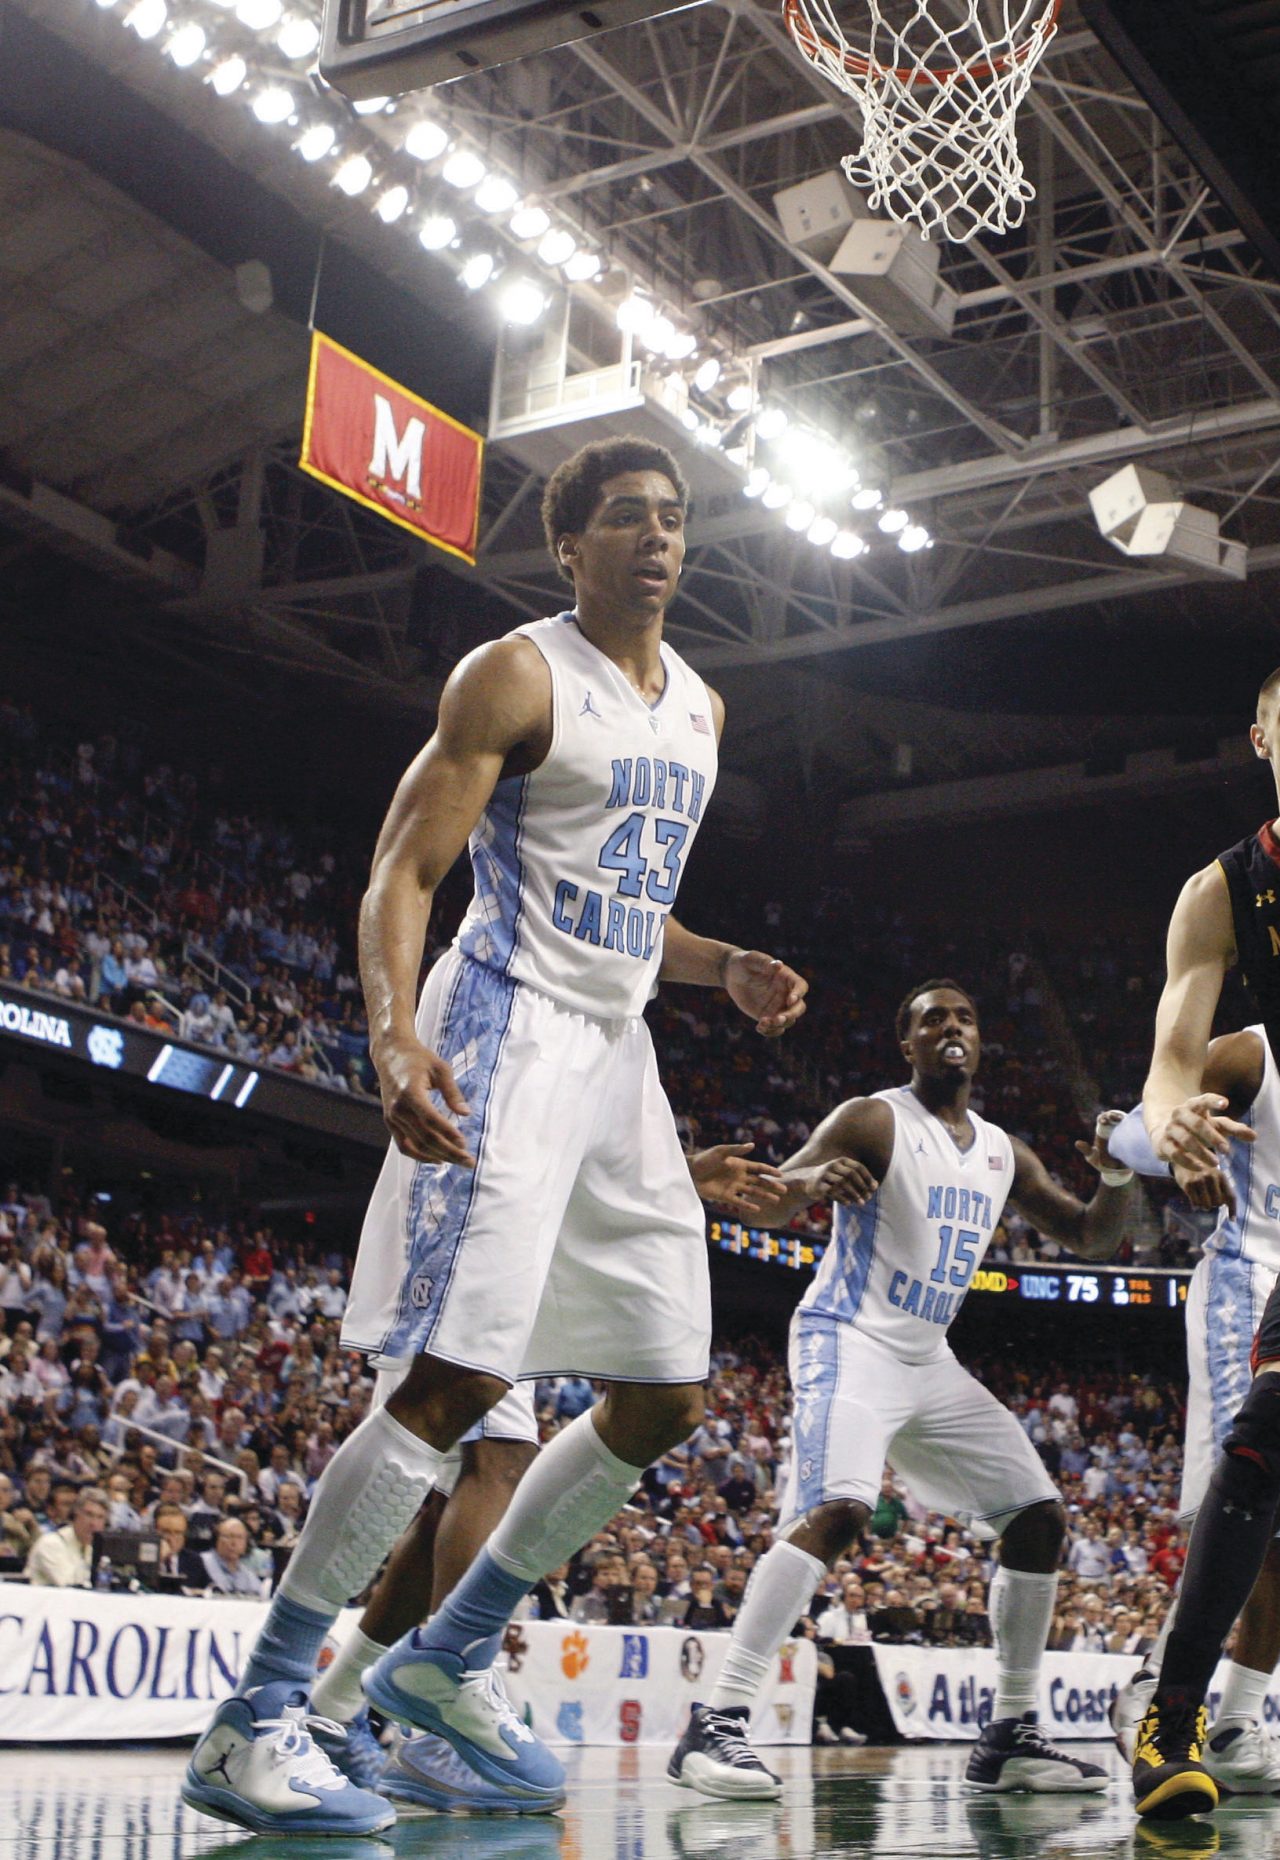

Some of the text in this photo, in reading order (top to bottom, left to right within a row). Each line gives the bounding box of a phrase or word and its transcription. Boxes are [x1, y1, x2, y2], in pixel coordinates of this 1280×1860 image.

[368, 393, 426, 500] M
[605, 756, 705, 823] NORTH
[598, 812, 689, 904] 43
[0, 1000, 72, 1048] OLINA
[927, 1186, 992, 1230] NORTH
[930, 1225, 979, 1288] 15
[1020, 1274, 1060, 1299] UNC
[1066, 1275, 1099, 1302] 75
[1115, 1277, 1125, 1291] 3
[928, 1673, 997, 1724] Atla
